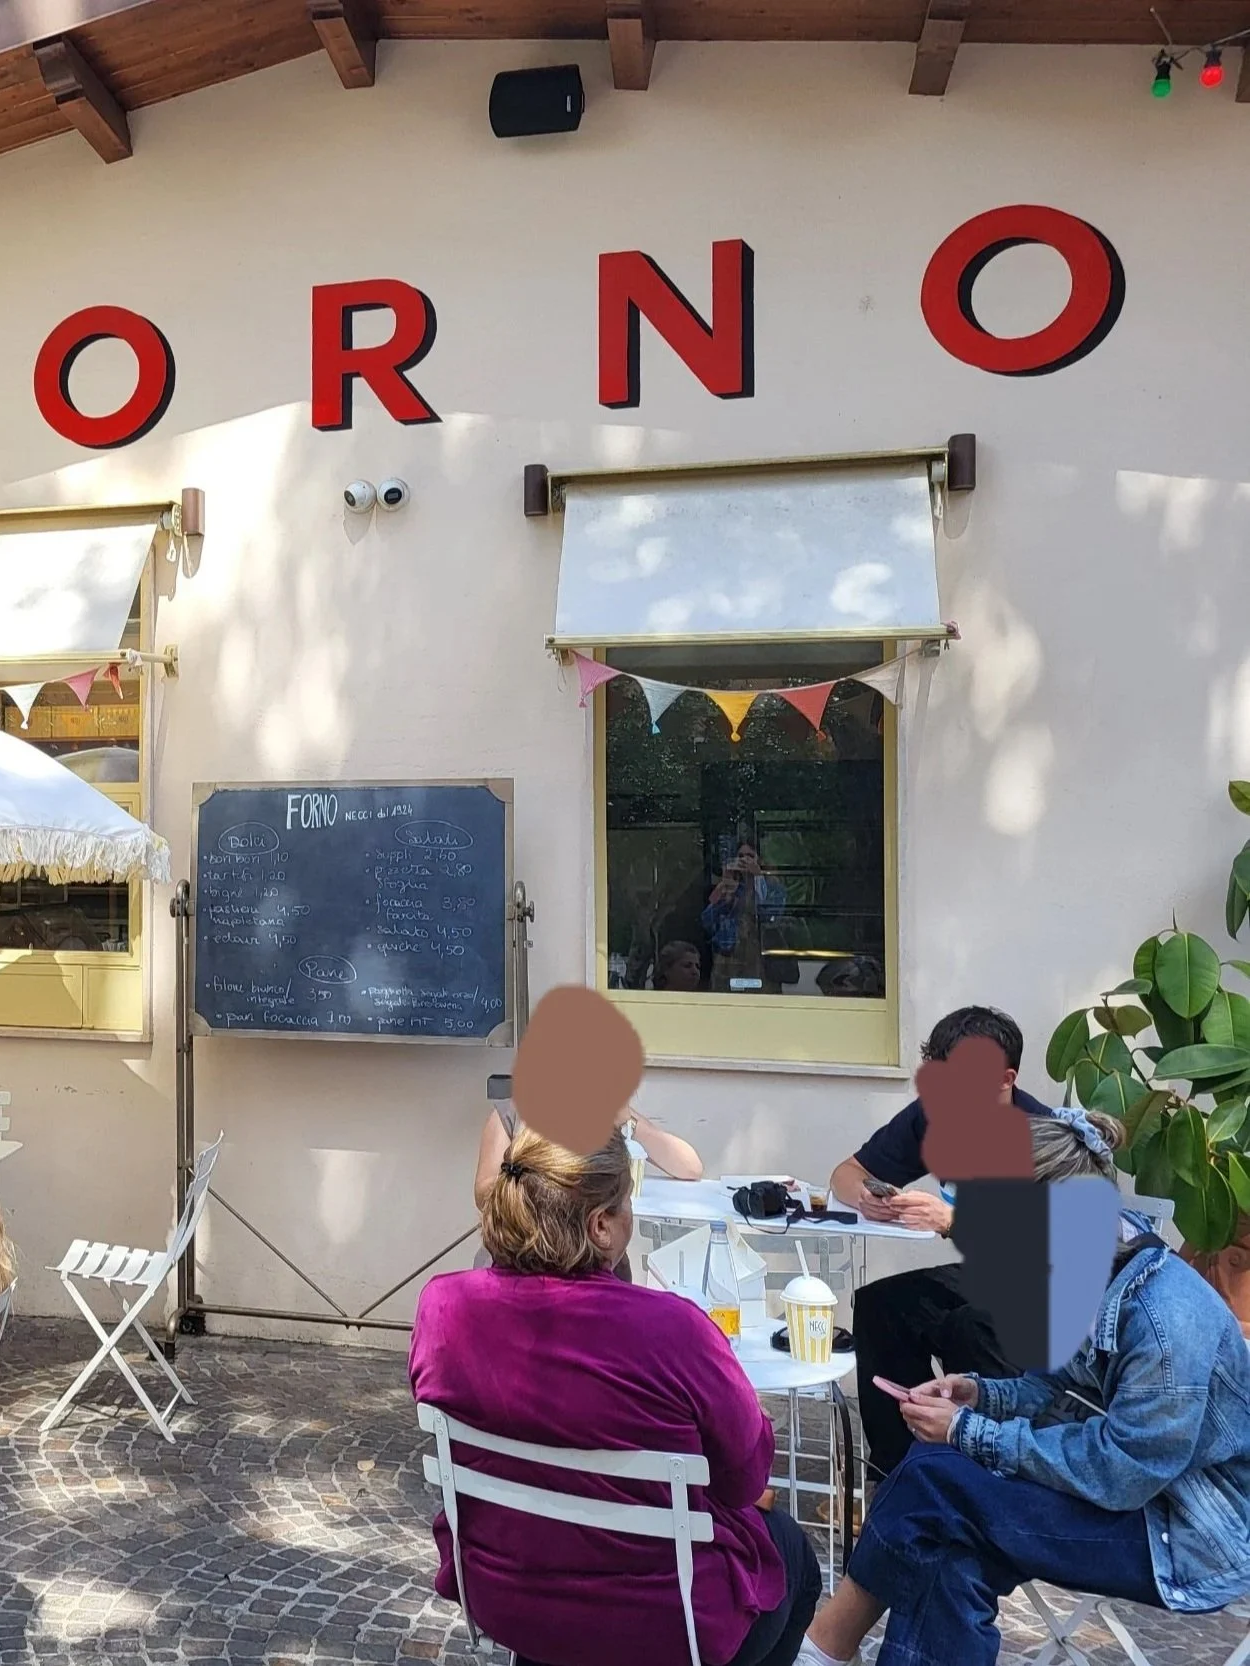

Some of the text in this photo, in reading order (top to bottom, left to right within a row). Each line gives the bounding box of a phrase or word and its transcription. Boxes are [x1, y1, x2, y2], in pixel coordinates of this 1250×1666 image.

[286, 793, 338, 830] FORNO
[345, 810, 373, 821] NECCI
[391, 803, 413, 816] 1924
[228, 833, 266, 849] Dolci
[437, 924, 472, 939] 4,50
[430, 940, 465, 959] 4,50
[444, 1016, 474, 1032] 5,00
